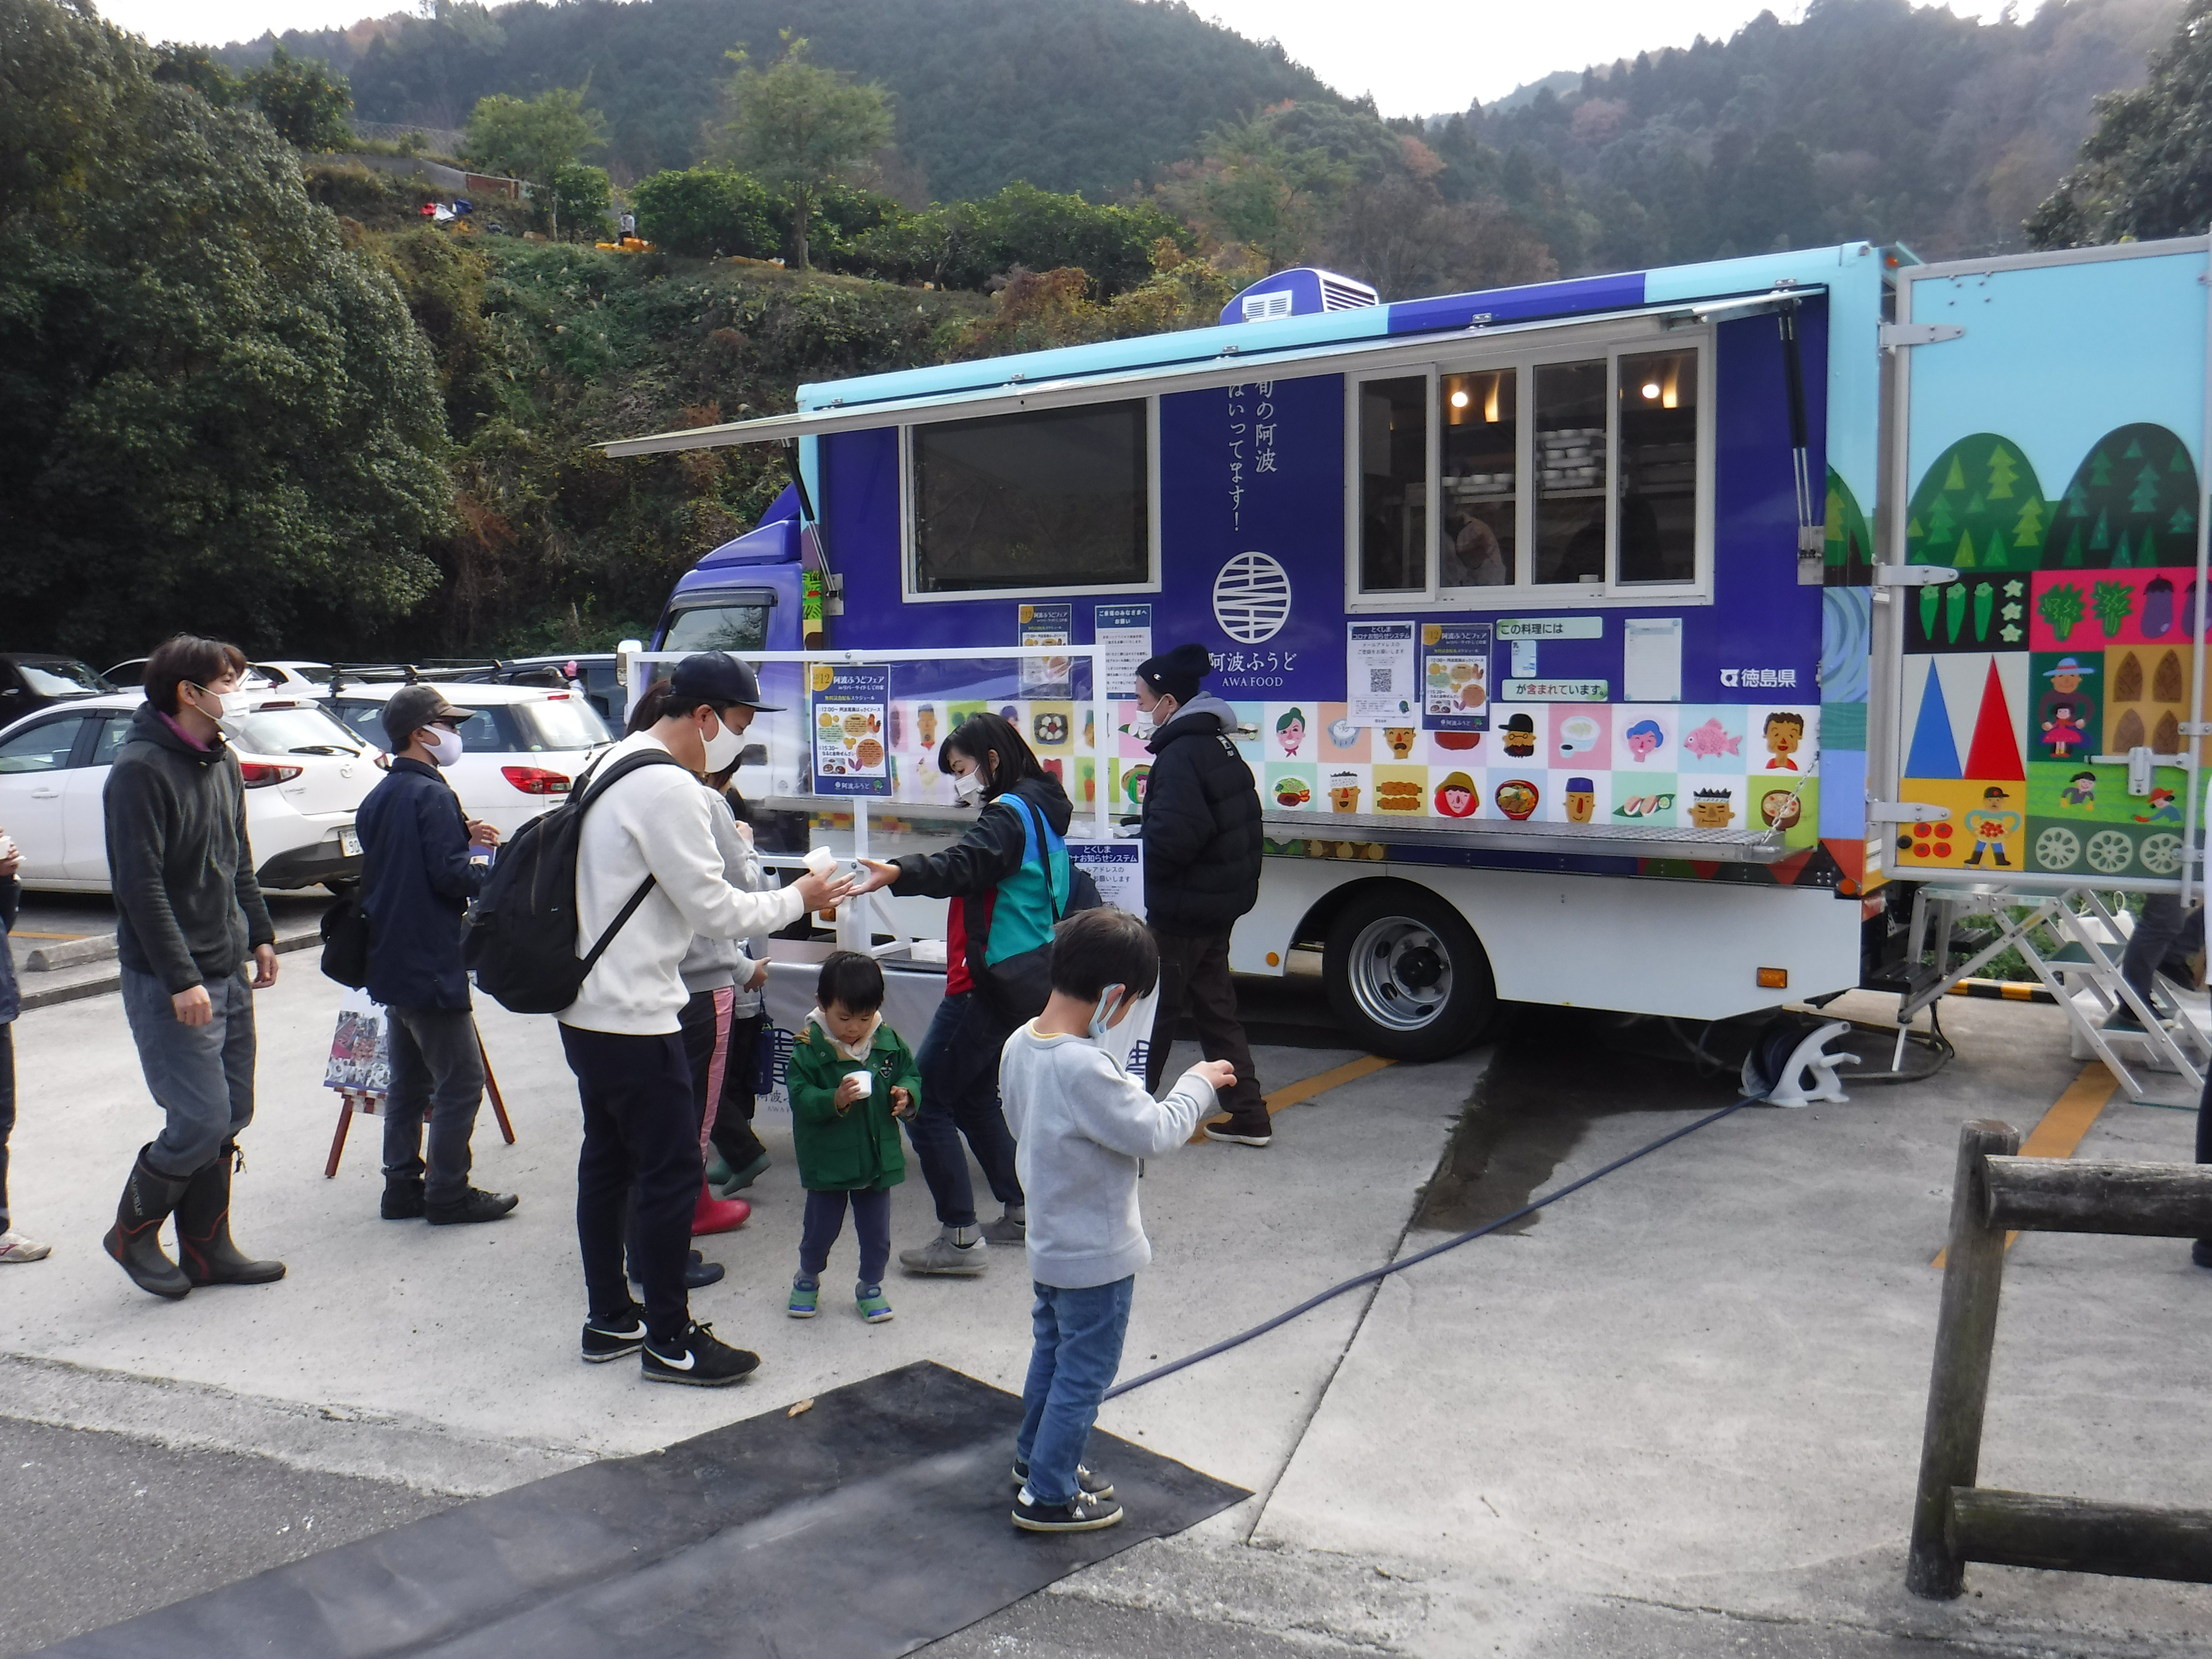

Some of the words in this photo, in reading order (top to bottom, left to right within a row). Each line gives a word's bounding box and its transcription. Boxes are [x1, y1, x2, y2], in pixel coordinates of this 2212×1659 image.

[1501, 623, 1563, 635] この料理には
[1208, 651, 1297, 673] 阿波ふうど
[833, 675, 885, 685] 阿波ふうどフェア
[1222, 677, 1248, 687] AWA
[1250, 677, 1283, 687] FOOD
[1741, 668, 1796, 688] 徳島県
[1516, 684, 1604, 696] が含まれています。
[1083, 845, 1112, 854] とくしま
